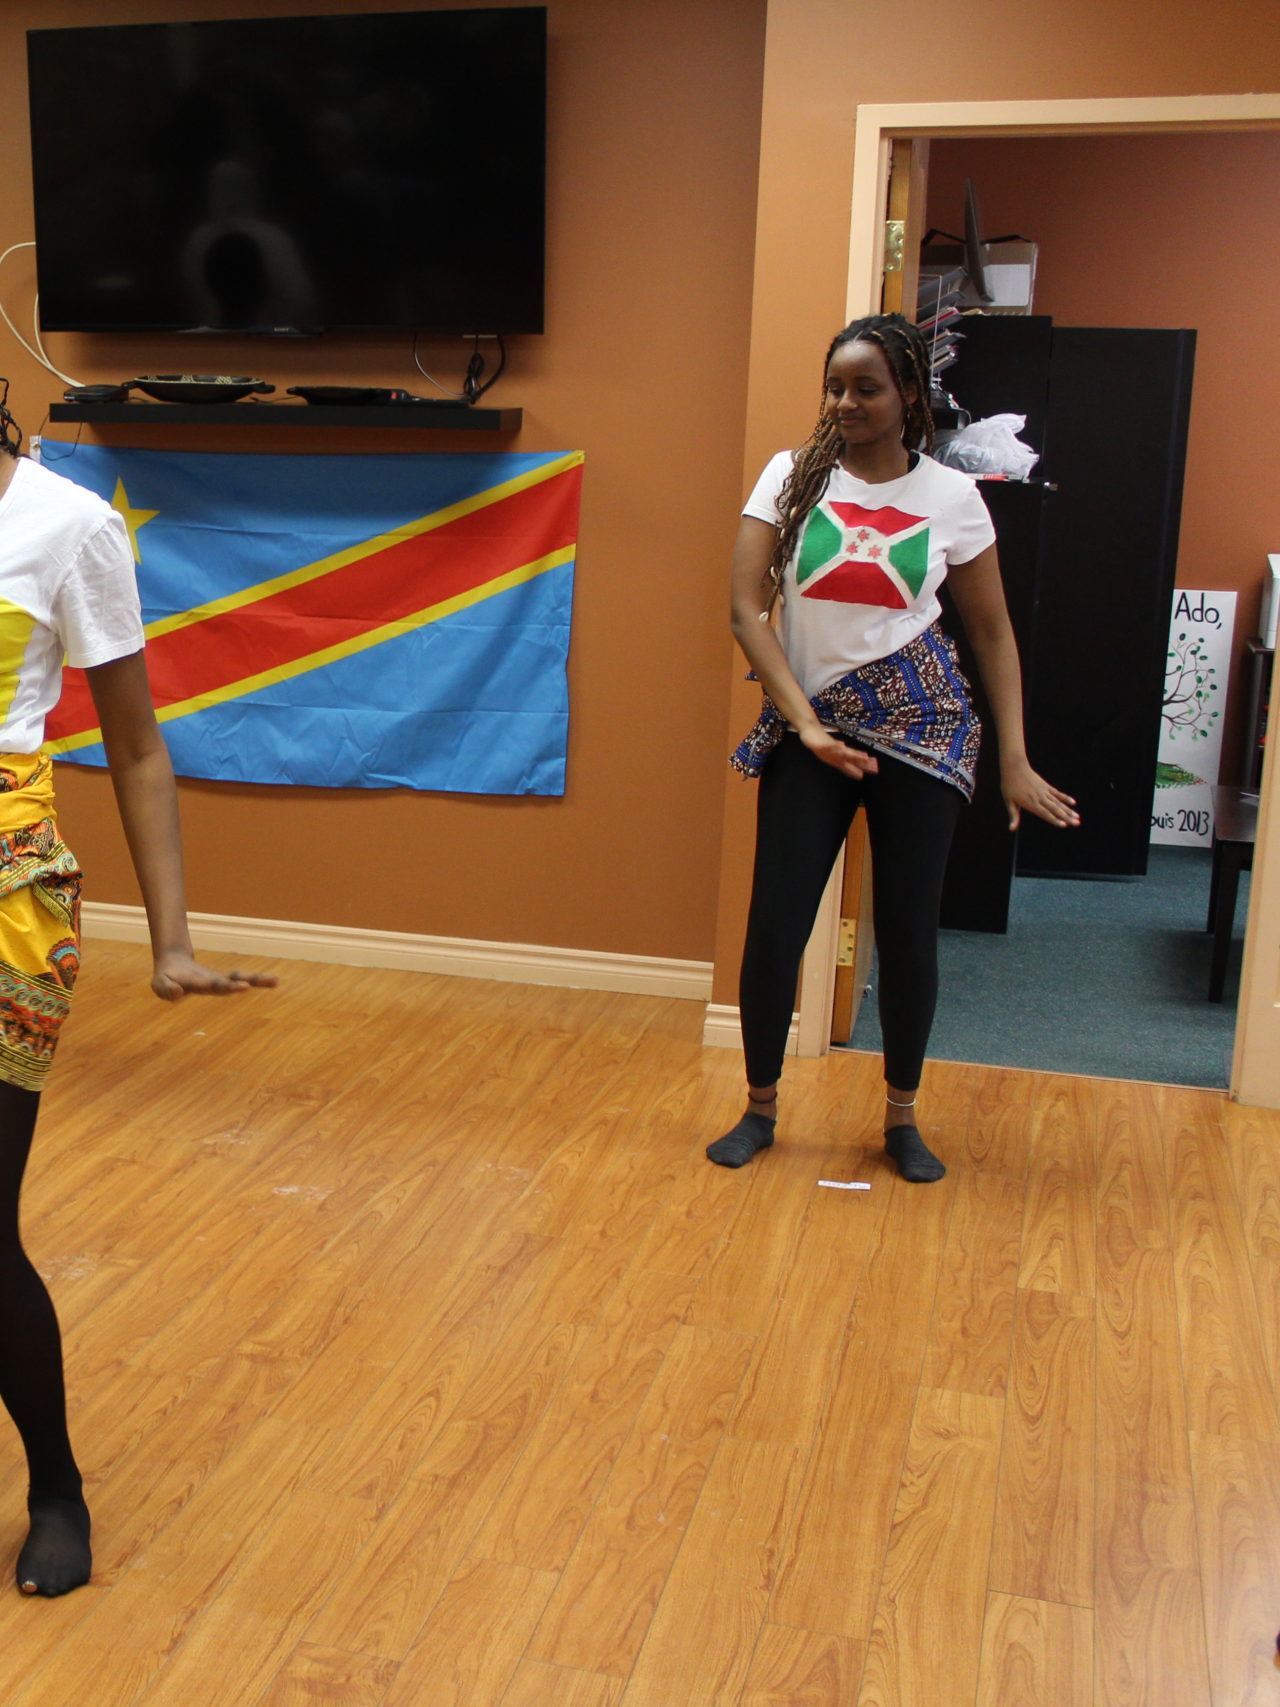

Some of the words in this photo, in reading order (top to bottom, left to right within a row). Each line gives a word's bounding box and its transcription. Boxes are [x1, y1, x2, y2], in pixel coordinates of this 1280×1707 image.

[1174, 592, 1222, 629] Ado,
[1150, 812, 1175, 829] puis
[1177, 809, 1210, 836] 2013
